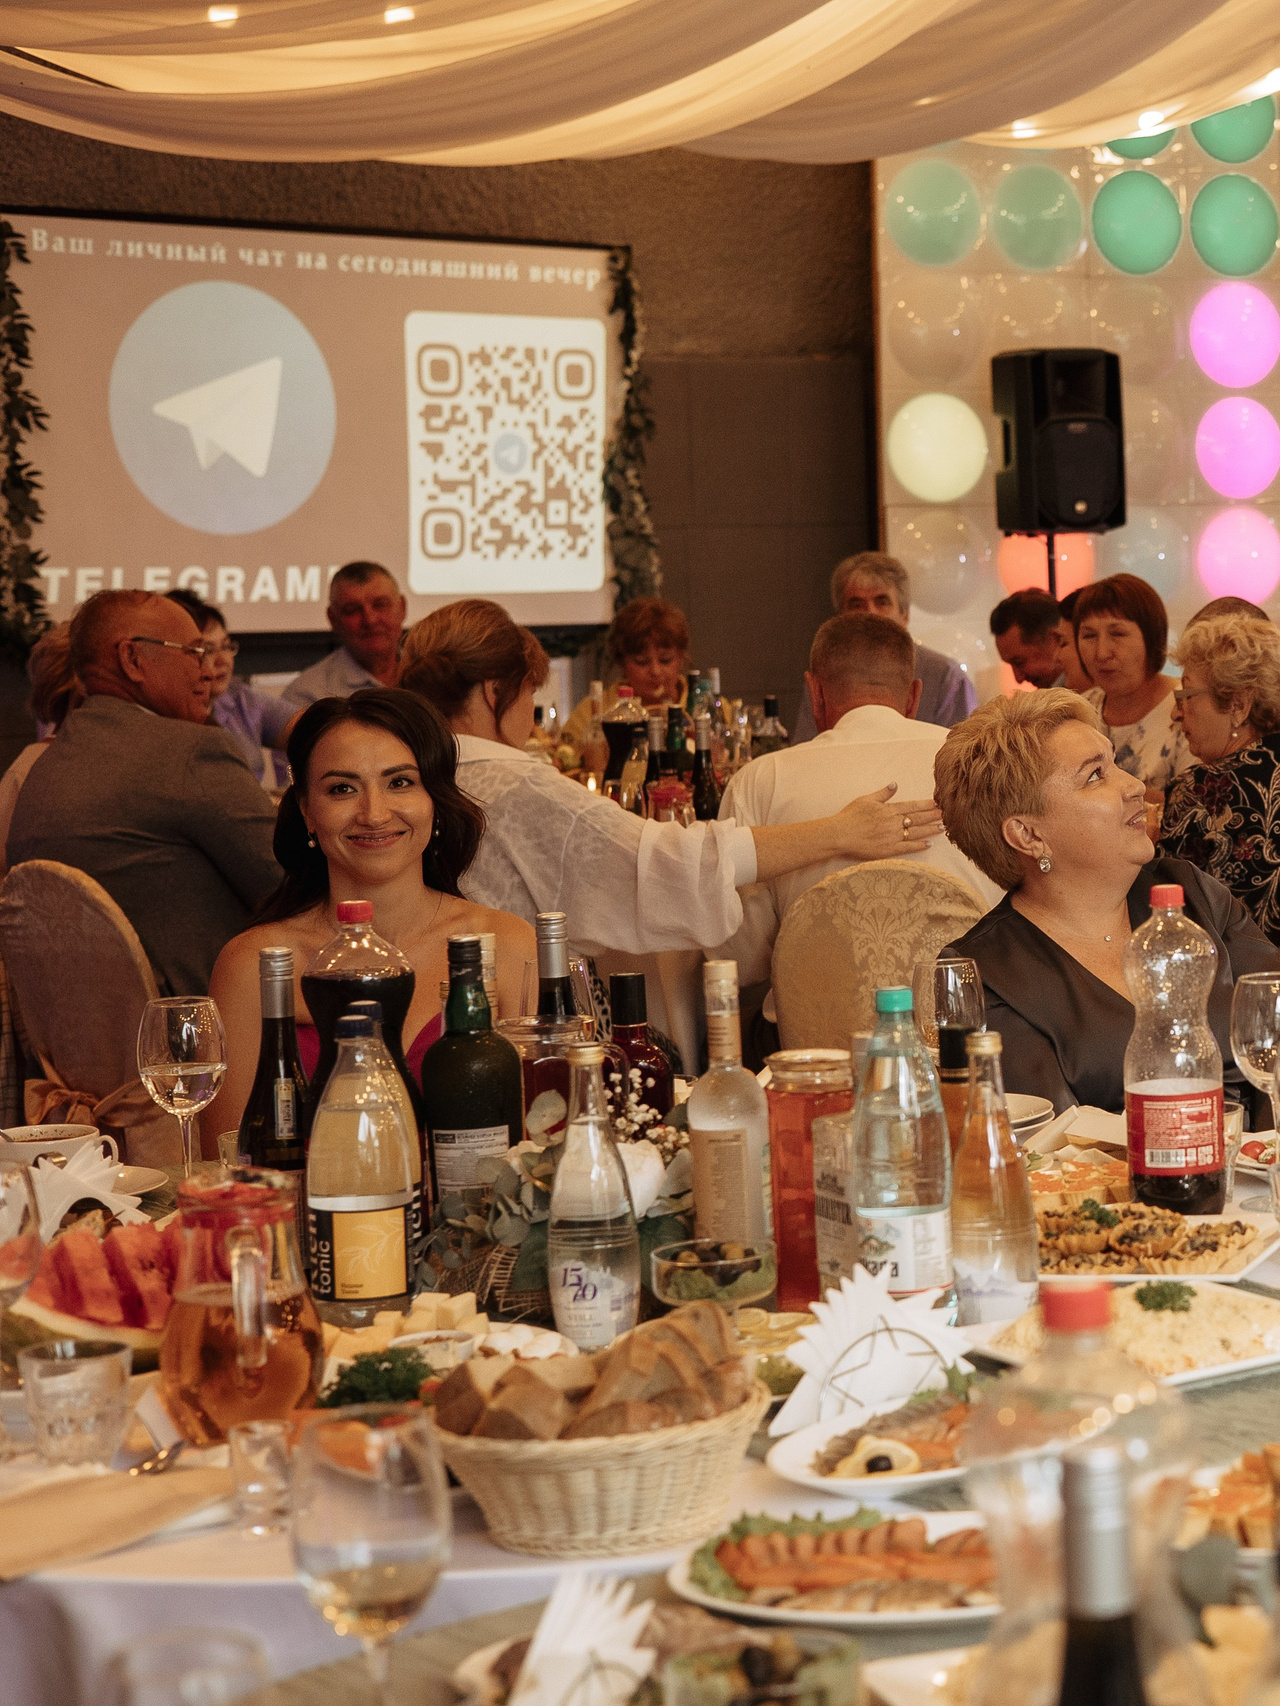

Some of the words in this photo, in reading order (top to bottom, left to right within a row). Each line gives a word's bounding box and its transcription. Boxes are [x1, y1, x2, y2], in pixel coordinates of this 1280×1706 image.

[31, 228, 95, 256] Ваш
[106, 238, 227, 265] личный
[238, 247, 286, 268] чат
[295, 252, 328, 271] на
[337, 253, 519, 282] сегодняшний
[528, 265, 601, 292] вечер
[317, 1240, 332, 1294] tonic
